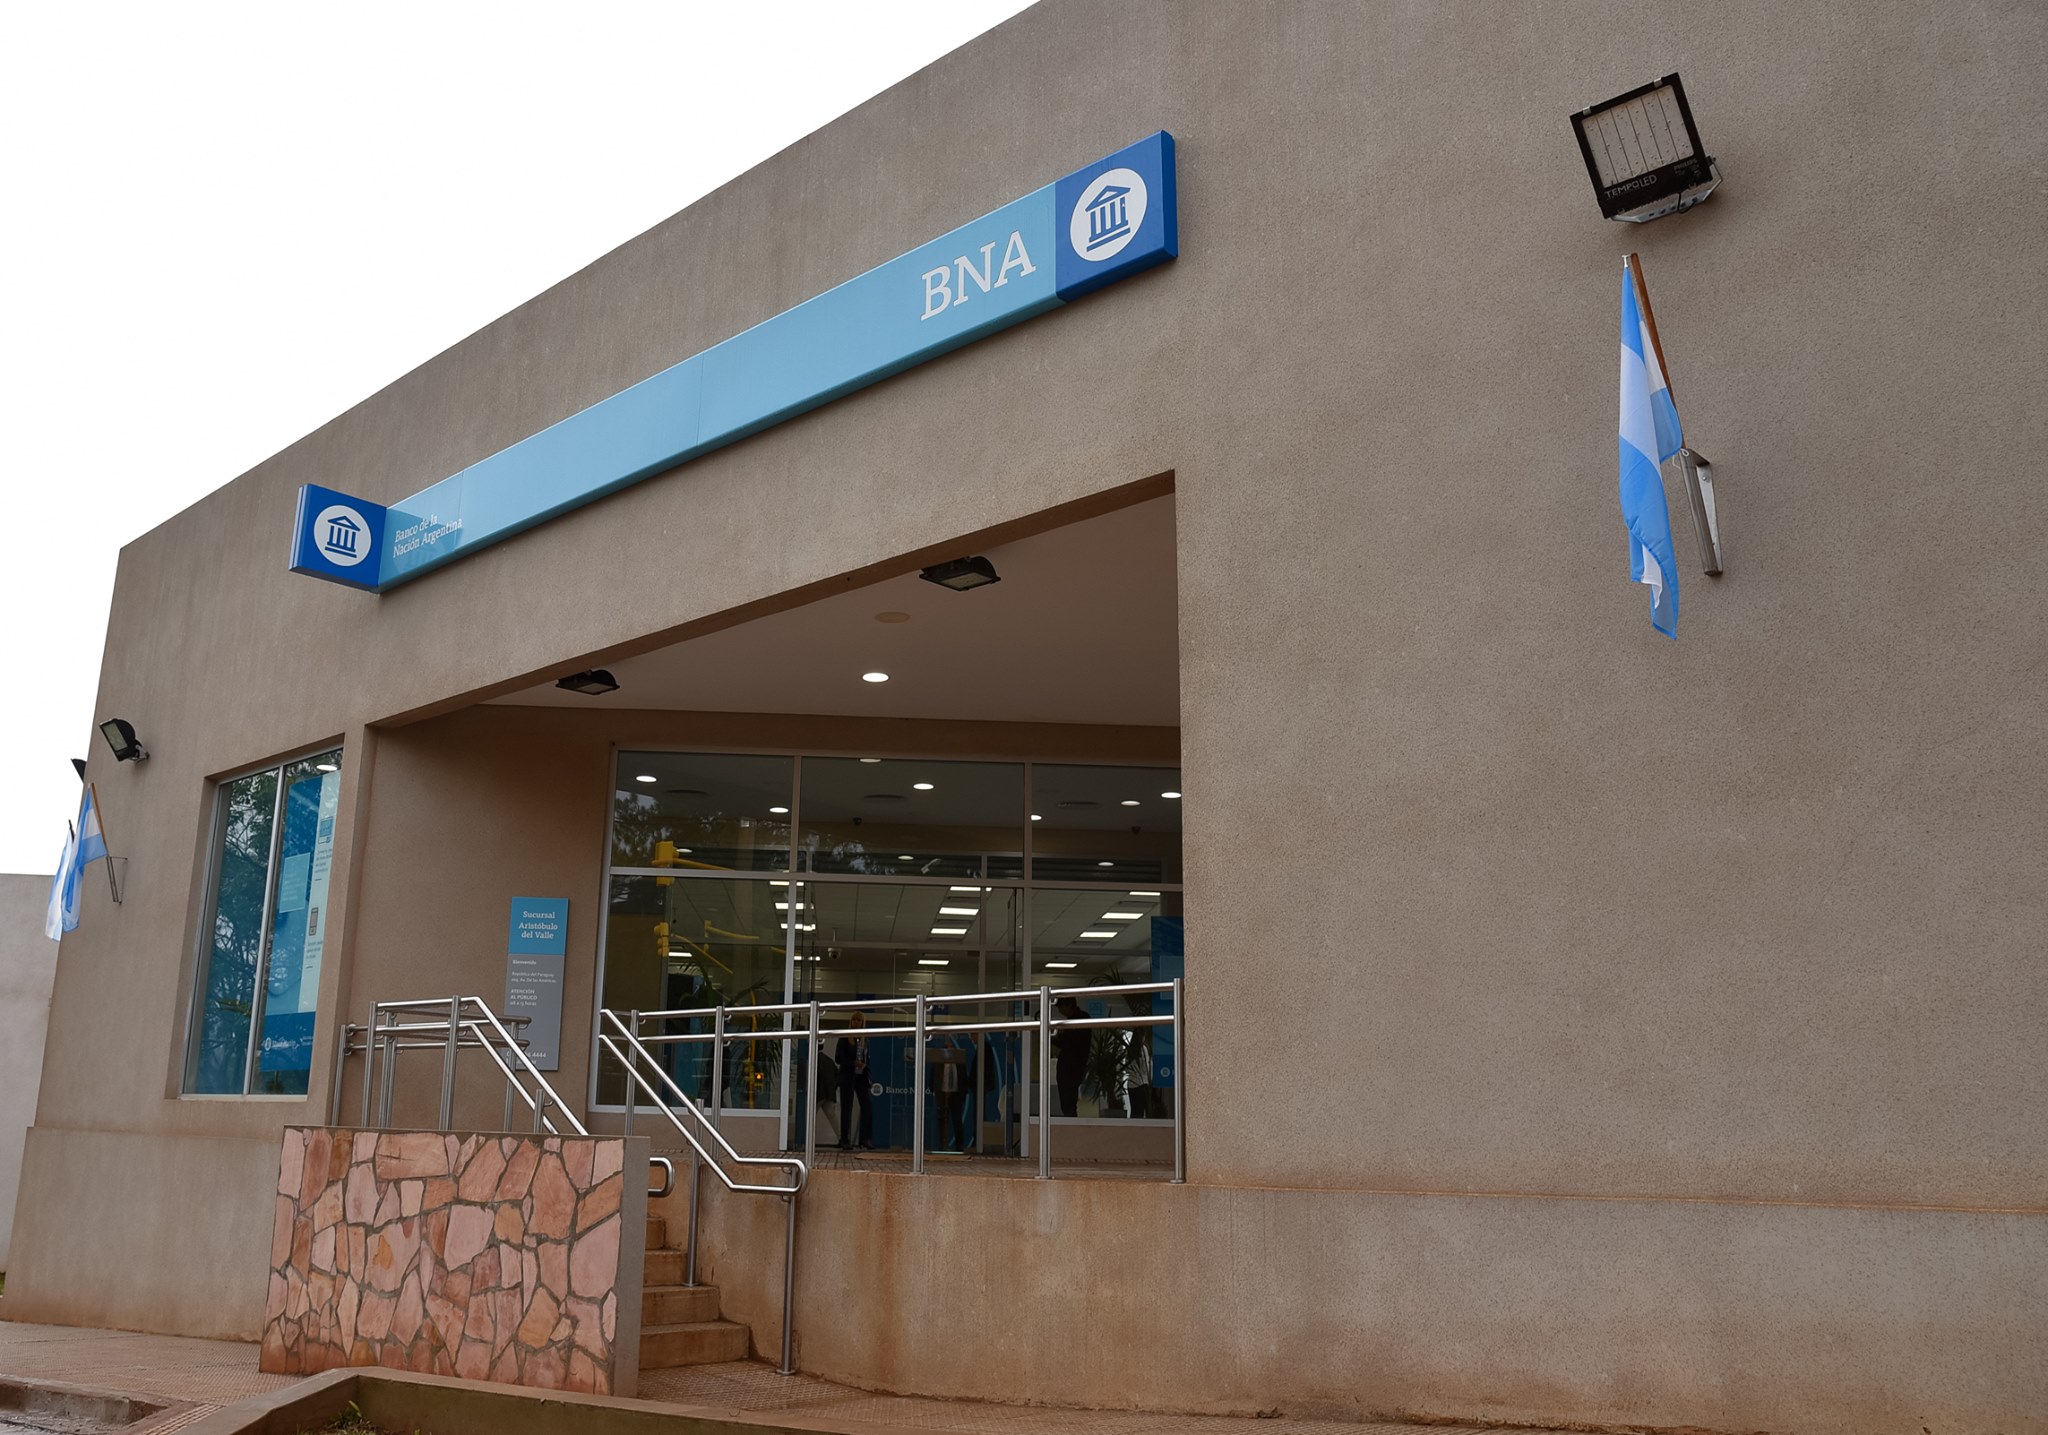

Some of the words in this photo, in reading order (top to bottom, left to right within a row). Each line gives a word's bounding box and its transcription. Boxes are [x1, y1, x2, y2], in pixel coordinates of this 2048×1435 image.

[921, 230, 1036, 321] BNA
[395, 525, 418, 543] Banco
[419, 518, 429, 532] de
[430, 514, 438, 527] la
[393, 538, 420, 558] Nación
[421, 518, 462, 546] Argentina
[523, 911, 555, 919] Sucursal
[518, 922, 558, 930] Aristóbulo
[535, 931, 554, 939] Valle
[885, 1086, 908, 1094] Banco
